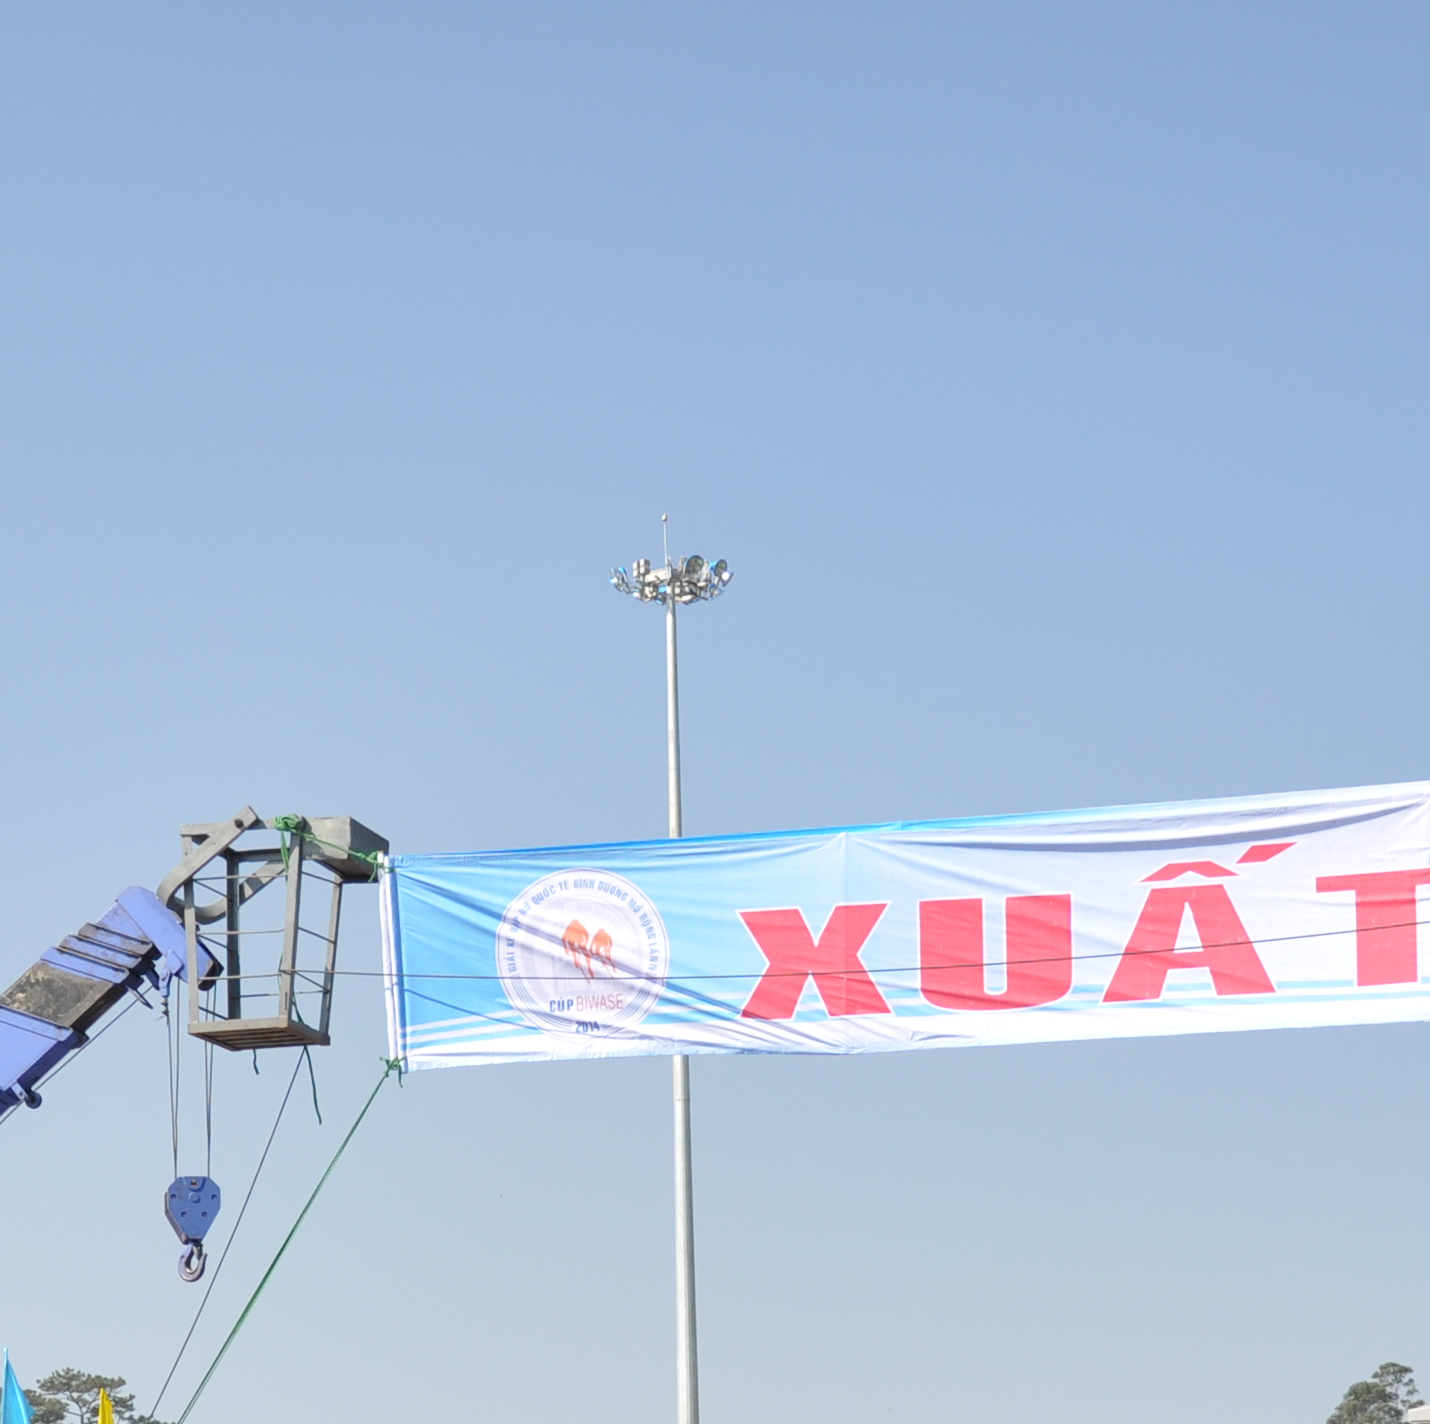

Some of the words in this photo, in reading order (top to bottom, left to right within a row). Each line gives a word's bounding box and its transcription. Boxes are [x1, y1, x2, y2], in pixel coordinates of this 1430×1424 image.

[573, 877, 595, 889] BÌNH
[550, 997, 574, 1013] CÚP
[576, 994, 624, 1011] BIWASE
[576, 1021, 600, 1033] 2014
